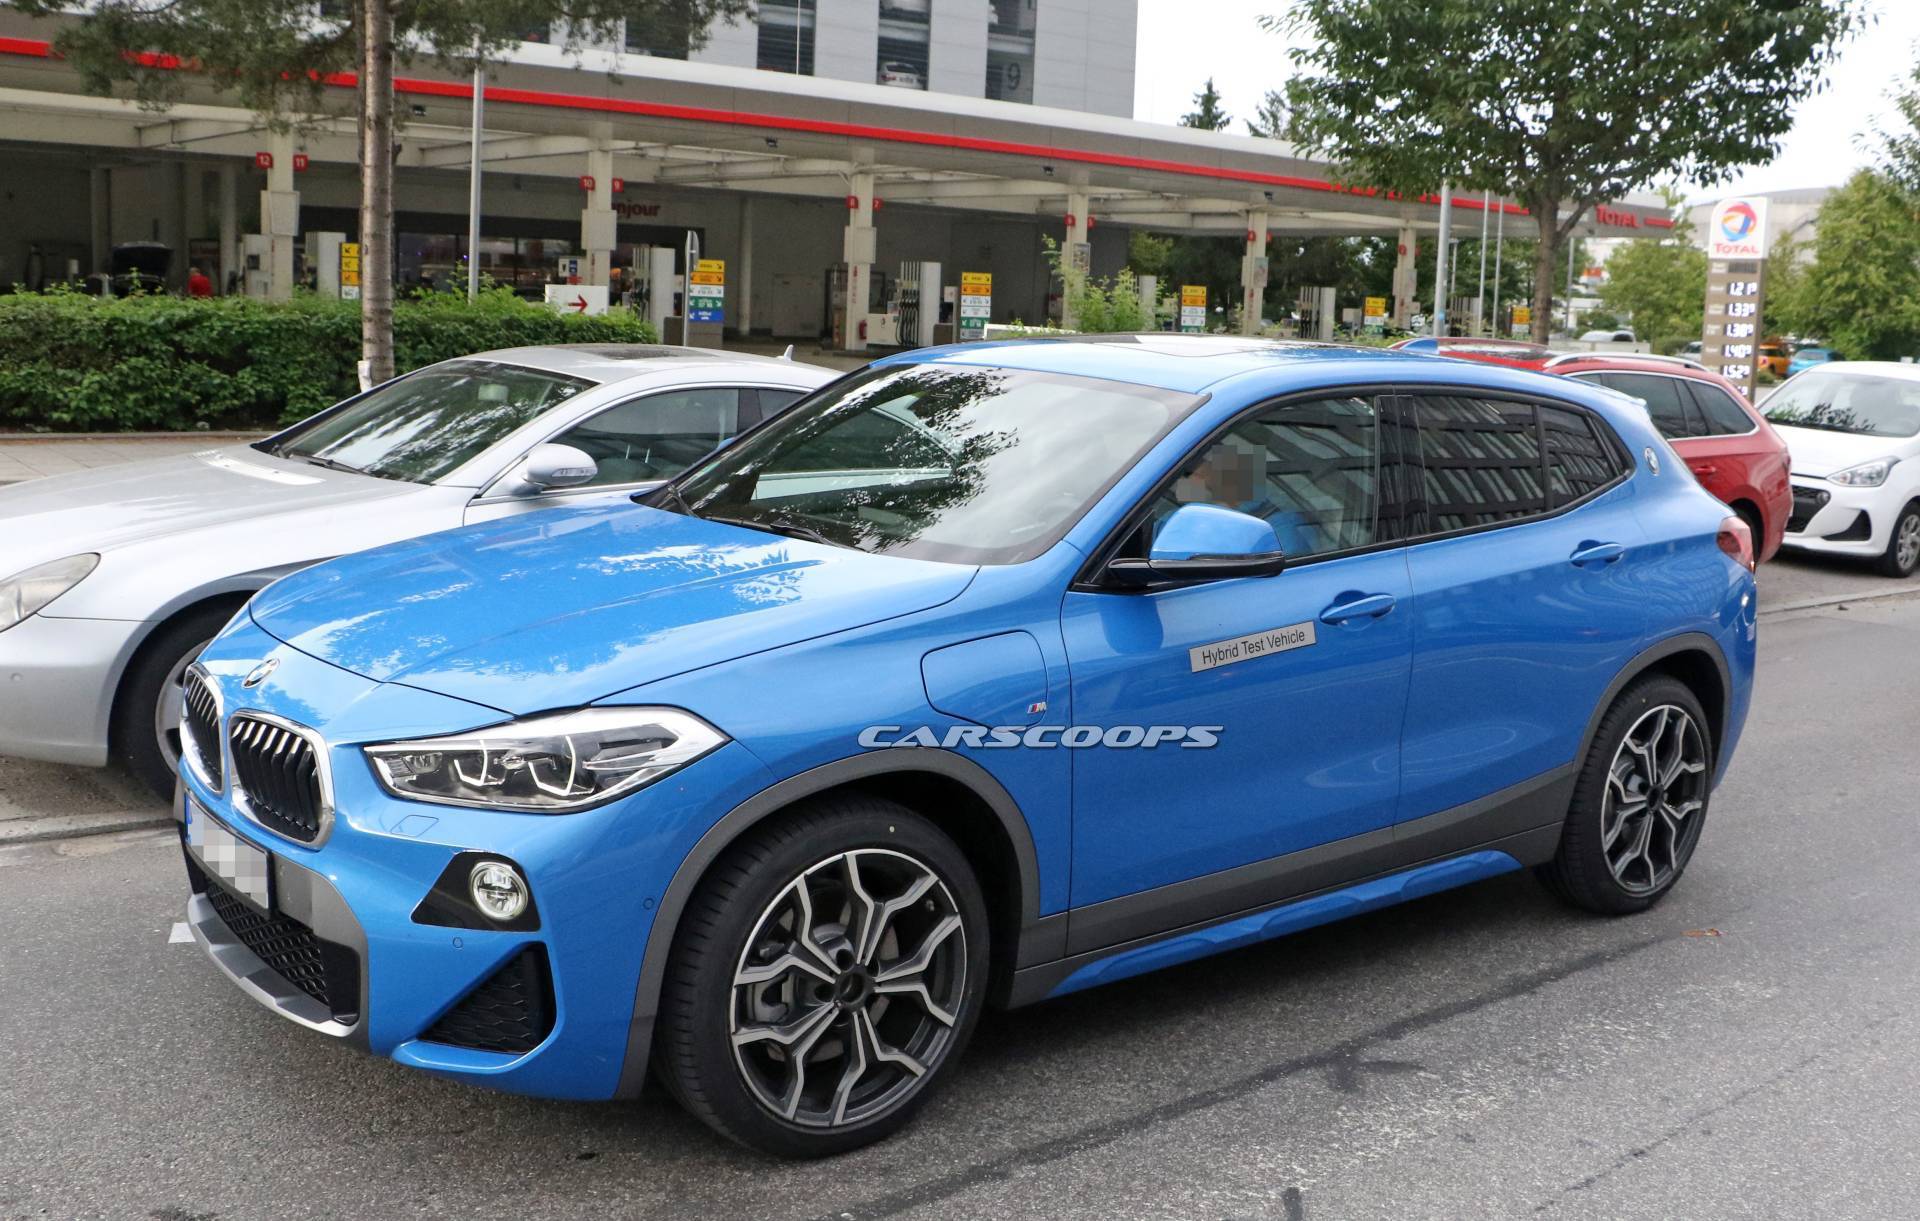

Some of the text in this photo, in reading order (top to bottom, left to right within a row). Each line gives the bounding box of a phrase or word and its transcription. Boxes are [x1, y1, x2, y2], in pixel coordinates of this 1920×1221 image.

[1008, 62, 1021, 90] 9
[260, 155, 270, 166] 12
[295, 157, 305, 168] 11
[1596, 204, 1643, 228] TOTAL
[1714, 243, 1760, 254] TOTAL
[1203, 629, 1305, 666] Hybrid Test Vehicle
